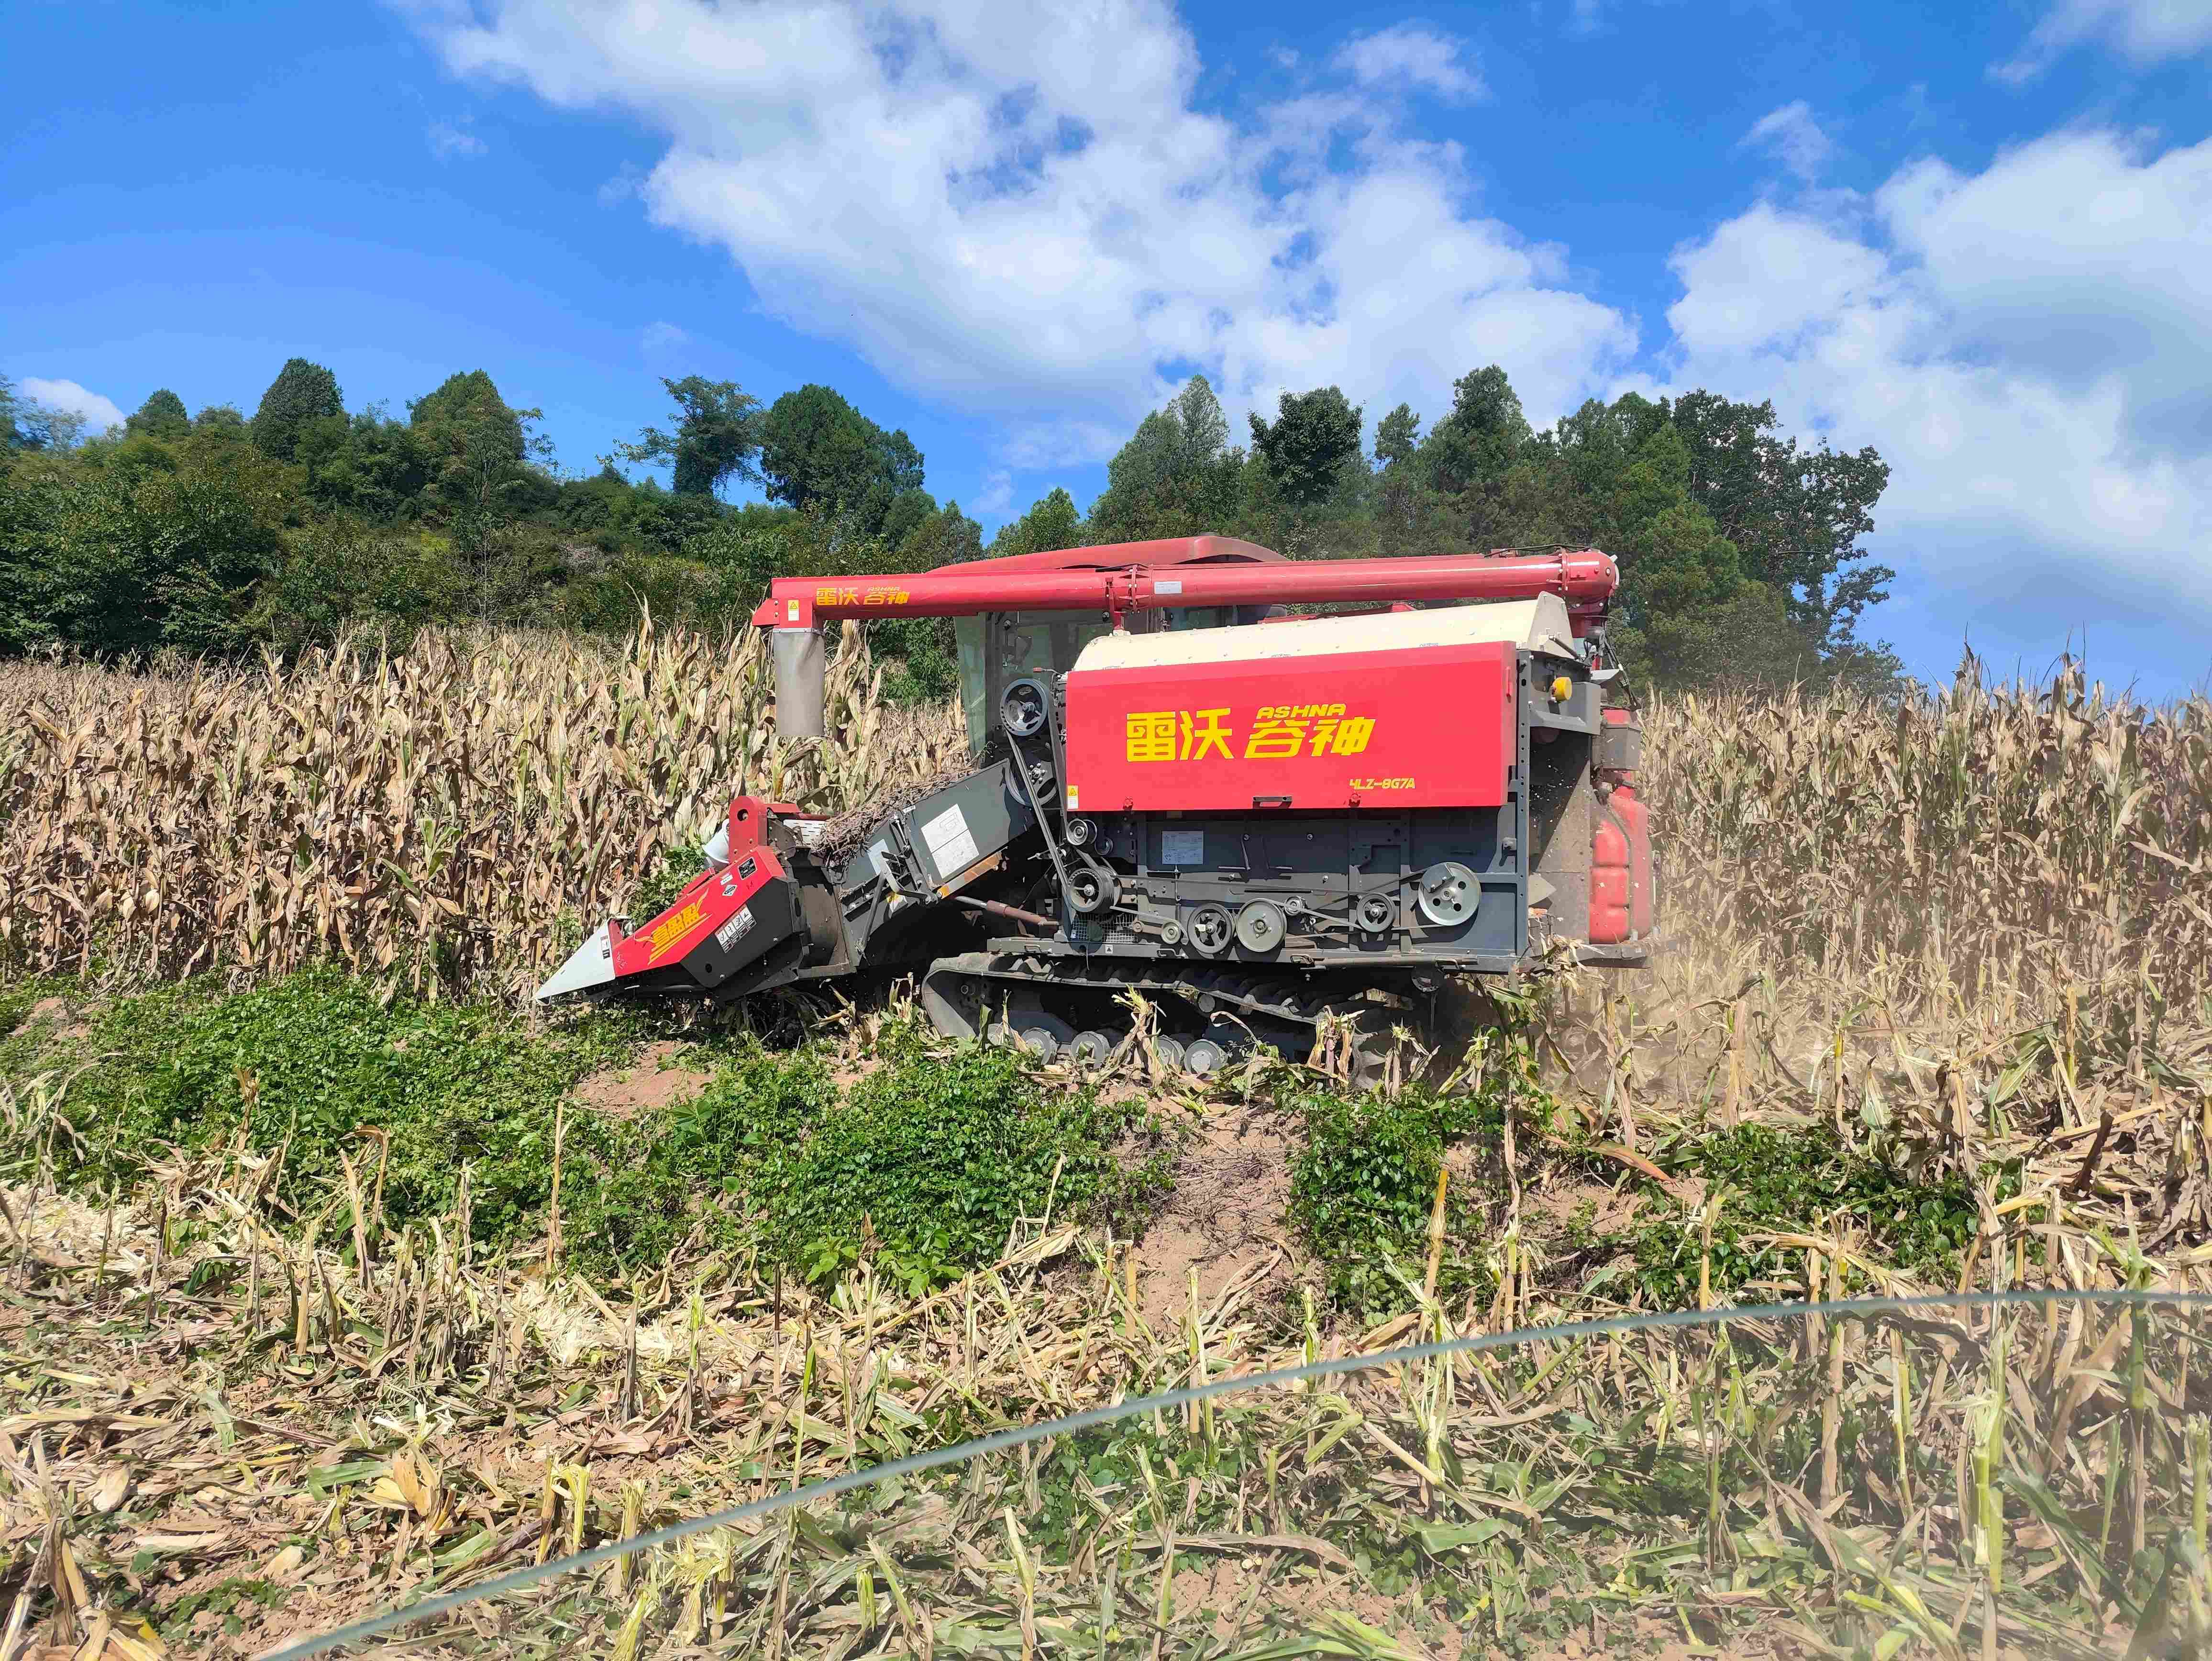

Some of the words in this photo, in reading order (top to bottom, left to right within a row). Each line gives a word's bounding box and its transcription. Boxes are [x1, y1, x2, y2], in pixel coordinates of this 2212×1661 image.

[1256, 704, 1347, 719] ASHNA
[1126, 708, 1376, 762] 雷沃谷神
[1349, 777, 1416, 790] 4LZ-8G7A
